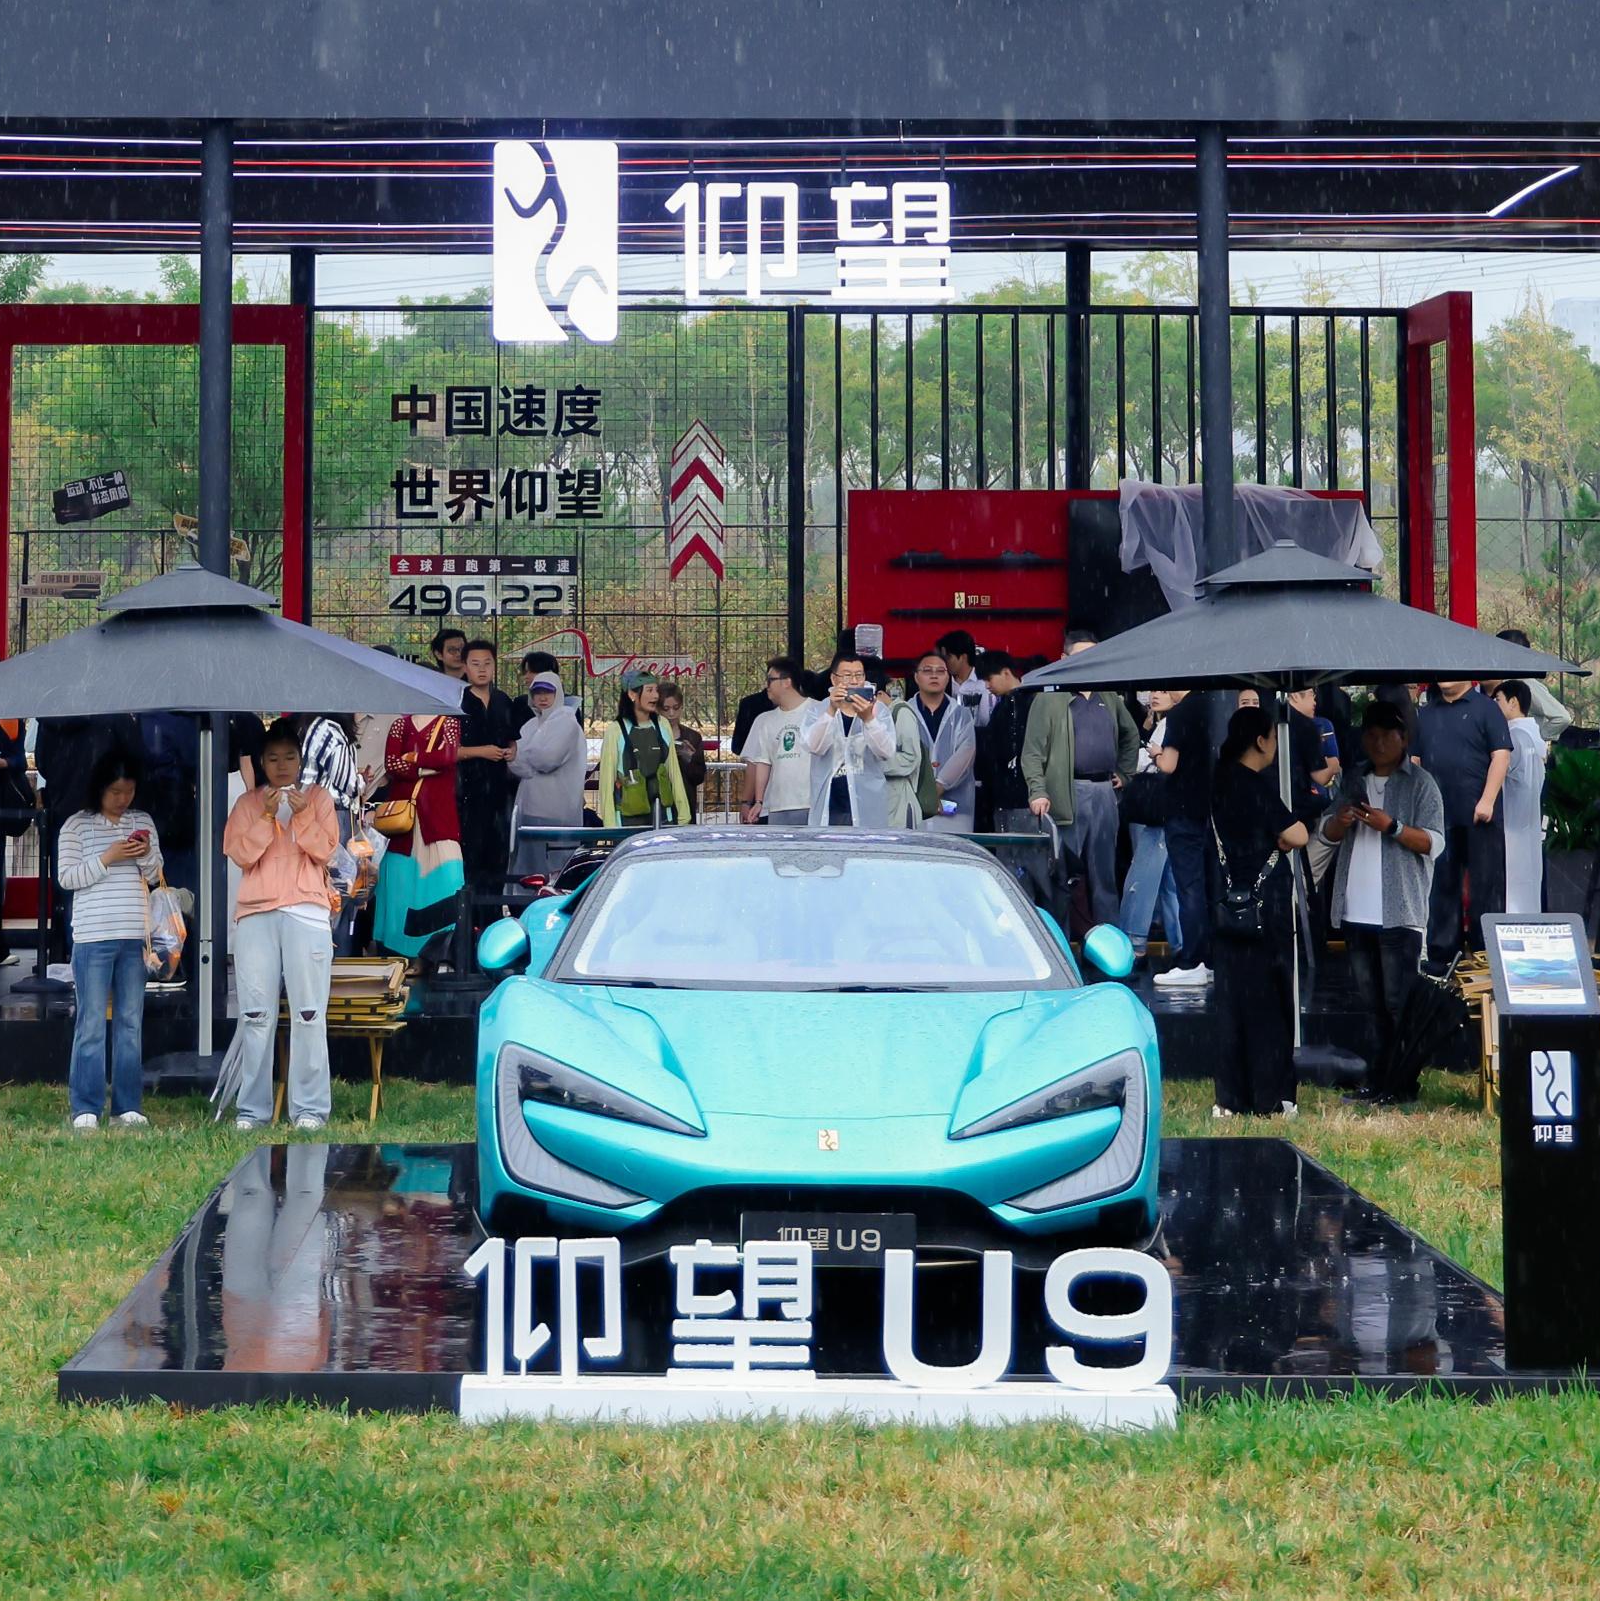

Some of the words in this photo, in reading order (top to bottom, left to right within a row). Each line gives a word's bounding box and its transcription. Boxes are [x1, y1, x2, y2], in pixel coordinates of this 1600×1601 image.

[664, 181, 955, 299] 仰望
[391, 384, 602, 437] 中国速度
[390, 468, 604, 523] 世界仰望
[397, 558, 571, 573] 全球超跑第一极速
[389, 584, 563, 616] 496.22
[1532, 1124, 1573, 1142] 仰望
[836, 1229, 881, 1252] U9
[463, 1237, 817, 1384] 仰望
[883, 1247, 1173, 1392] U9
